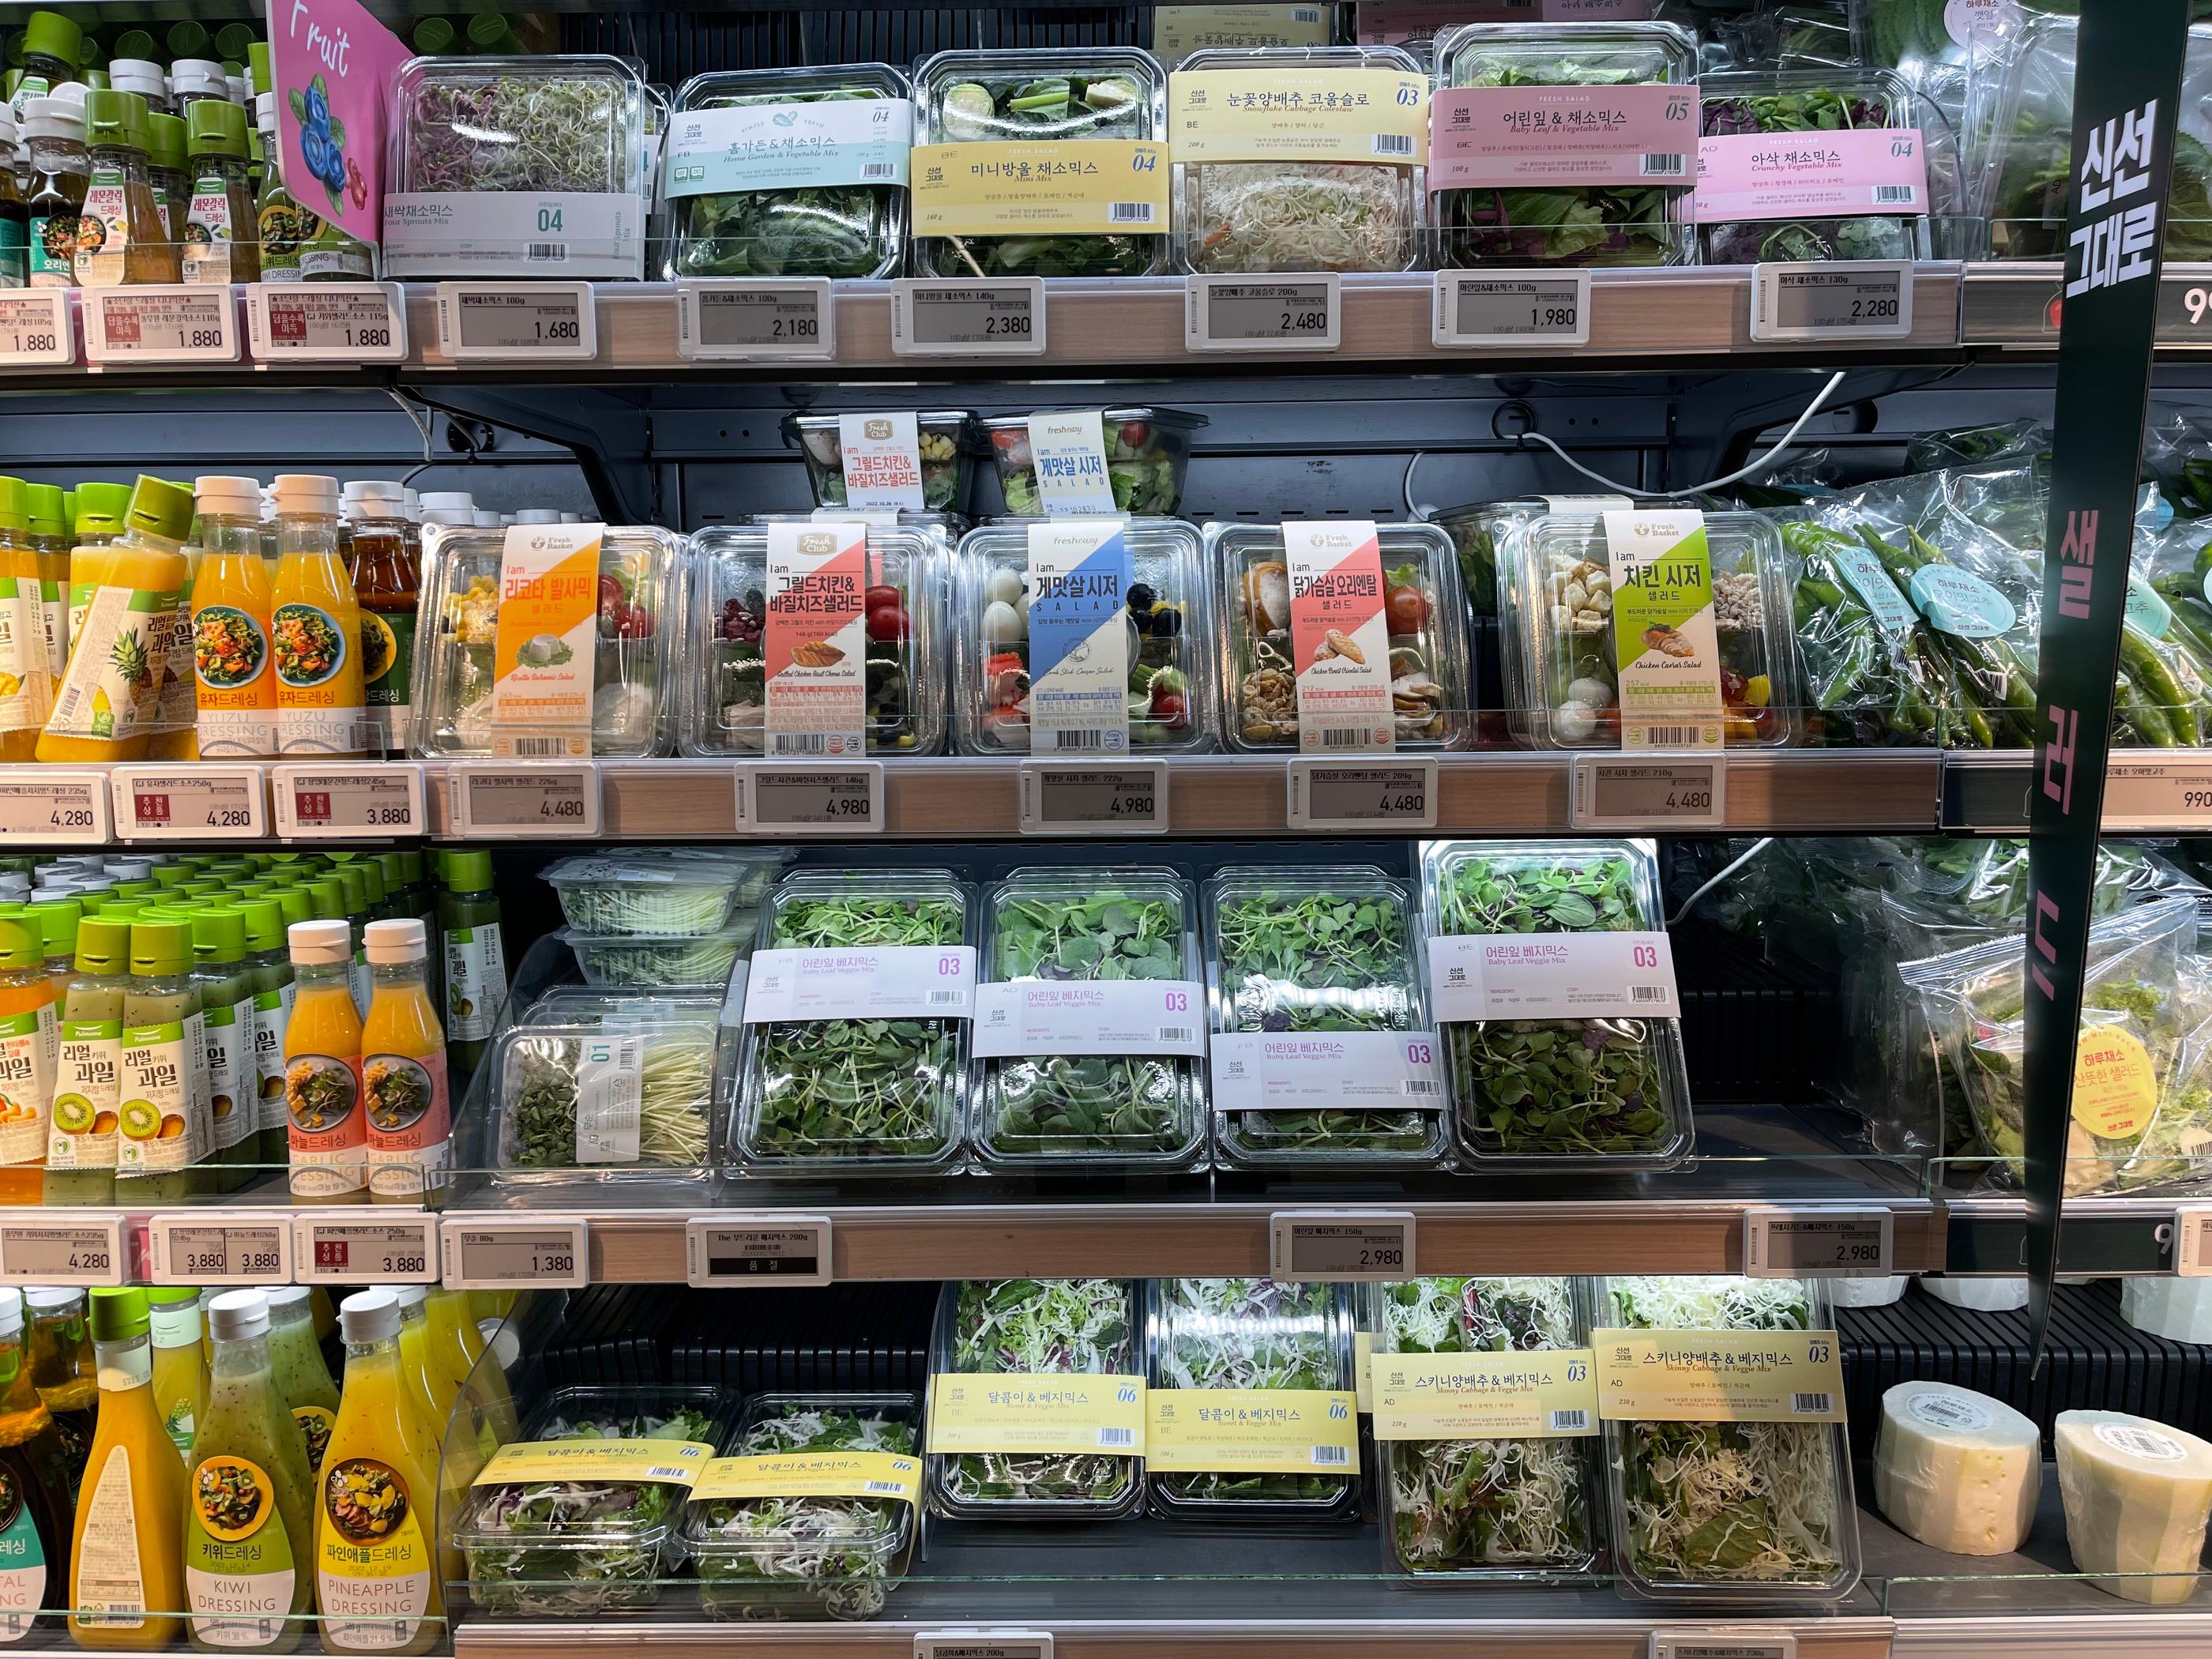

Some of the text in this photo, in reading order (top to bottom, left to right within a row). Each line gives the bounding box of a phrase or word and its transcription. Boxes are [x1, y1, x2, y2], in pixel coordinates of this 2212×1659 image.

[291, 0, 351, 77] Fruit
[1227, 92, 1369, 107] 눈꽃양배추 코울슬로
[1396, 88, 1419, 107] 03
[1243, 103, 1354, 113] Snowflake Cabbage Coleslaw
[1666, 102, 1689, 121] 05
[872, 111, 890, 122] 04
[1503, 110, 1627, 126] 어린잎 채소믹스
[1510, 125, 1601, 135] Baby Vegetable
[1751, 149, 1841, 166] 아삭 채소믹스
[1890, 141, 1913, 158] 04
[2081, 99, 2158, 213] 신선
[971, 161, 1099, 177] 미니방울 채소믹스
[1133, 154, 1156, 172] 04
[1751, 164, 1785, 172] Crunchy
[89, 190, 122, 204] 레몬갈릭
[193, 198, 226, 212] 레몬갈릭
[100, 205, 122, 216] 드레싱
[204, 213, 225, 224] 드레싱
[384, 205, 453, 218] 새싹채소믹스
[538, 209, 562, 232] 04
[2066, 202, 2158, 299] 그대로
[1830, 275, 1848, 284] 130g
[1531, 307, 1575, 326] 1,980
[1851, 299, 1898, 318] 2,280
[773, 319, 817, 337] 2,180
[986, 317, 1030, 334] 2,380
[1281, 312, 1326, 330] 2,480
[179, 330, 222, 347] 1,880
[345, 329, 389, 347] 1,880
[534, 322, 577, 339] 1,680
[13, 334, 56, 352] 1,880
[1048, 425, 1082, 435] fresheasy
[852, 455, 912, 471] 그릴드치킨&
[1040, 457, 1101, 477] 게맛살 시저
[847, 472, 919, 487] 바질치즈샐러드
[807, 544, 828, 553] Club
[1054, 536, 1098, 545] fresheasy
[1624, 564, 1701, 588] 치킨 시저
[506, 577, 591, 601] 리코타 발사믹
[778, 576, 855, 594] 그릴드치킨&
[1036, 575, 1118, 598] 게맛살 시저
[1294, 574, 1377, 598] 닭가슴살 오리엔탈
[1938, 578, 1979, 592] 하루채소
[1648, 591, 1680, 600] 샐러드
[770, 595, 863, 613] 바질치즈샐러드
[1322, 600, 1352, 610] 샐러드
[200, 693, 258, 706] 유자드레싱
[279, 691, 335, 705] 유자드레싱
[207, 713, 249, 723] YUZU
[286, 712, 325, 721] YUZU
[198, 724, 268, 737] DRESSING
[827, 799, 869, 816] 4,980
[1111, 796, 1153, 814] 4,980
[1380, 795, 1424, 811] 4,480
[1666, 792, 1710, 808] 4,480
[2184, 792, 2212, 807] 990
[367, 809, 410, 824] 3,880
[540, 800, 584, 818] 4,480
[51, 811, 93, 826] 4,280
[207, 811, 250, 826] 4,280
[1486, 946, 1568, 957] 어린잎 베지믹스
[1634, 946, 1657, 967] 03
[803, 957, 878, 969] 어린잎 베지믹스
[939, 957, 959, 975] 03
[1029, 991, 1104, 1002] 어린잎 베지믹스
[1166, 993, 1187, 1011] 03
[63, 1045, 90, 1061] 리얼
[1266, 1042, 1344, 1053] 어린잎 베지믹스
[1408, 1045, 1431, 1063] 03
[124, 1050, 152, 1067] 리얼
[2083, 1049, 2124, 1066] 하루채소
[75, 1062, 115, 1083] 과일
[137, 1064, 178, 1088] 과일
[2075, 1063, 2141, 1089] 산뜻한 샐러드
[292, 1134, 346, 1149] 마늘드레싱
[369, 1133, 421, 1147] 마늘드레싱
[69, 1254, 110, 1269] 4,280
[187, 1255, 224, 1267] 3,880
[243, 1254, 279, 1267] 3,880
[1360, 1250, 1401, 1266] 2,980
[1837, 1245, 1879, 1262] 2,980
[383, 1258, 424, 1273] 3,880
[532, 1257, 573, 1271] 1,380
[1643, 1351, 1793, 1366] 스키니양배추 베지믹스
[1808, 1346, 1829, 1363] 03
[1416, 1373, 1552, 1388] 스키니양배추 베지믹스
[1567, 1365, 1586, 1381] 03
[988, 1390, 1089, 1403] 달콤이 베지믹스
[1117, 1388, 1136, 1402] 06
[1198, 1408, 1300, 1421] 달콤이 베지믹스
[1329, 1404, 1348, 1420] 06
[203, 1544, 261, 1561] 키위드레싱
[327, 1544, 411, 1563] 파인애플드레싱
[214, 1580, 250, 1594] KIWI
[329, 1580, 414, 1597] PINEAPPLE
[198, 1596, 275, 1612] DRESSING
[332, 1598, 411, 1616] DRESSING
